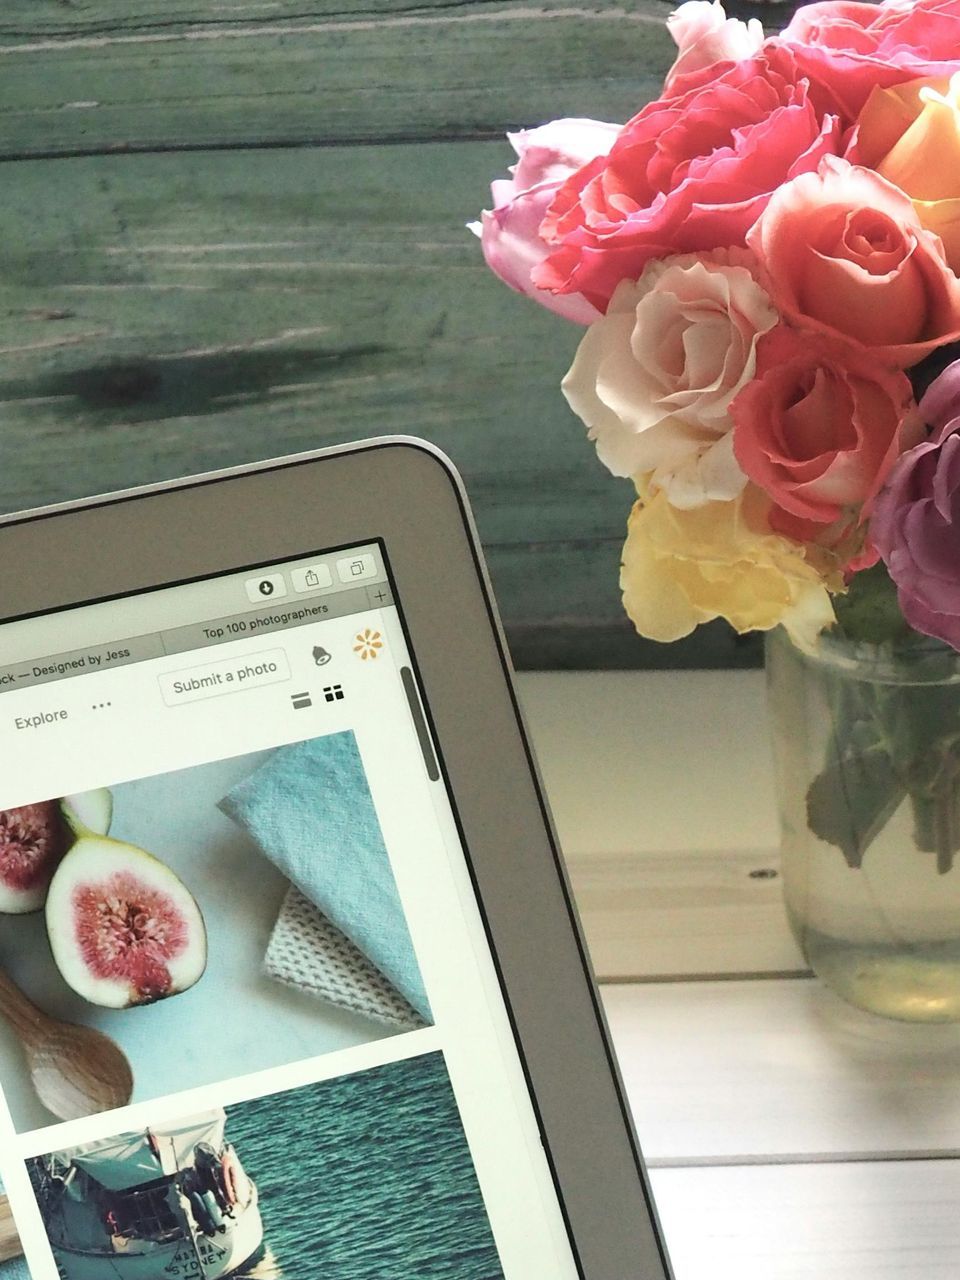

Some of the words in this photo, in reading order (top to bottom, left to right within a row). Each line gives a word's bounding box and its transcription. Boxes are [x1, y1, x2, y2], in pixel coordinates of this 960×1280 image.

[203, 628, 224, 639] Top
[227, 621, 247, 633] 100
[249, 604, 329, 630] photographers
[33, 658, 85, 677] Designed
[88, 655, 101, 665] by
[105, 648, 130, 661] Jess
[173, 673, 223, 694] Submit
[225, 673, 234, 682] a
[237, 662, 277, 682] photo
[15, 709, 68, 730] Explore
